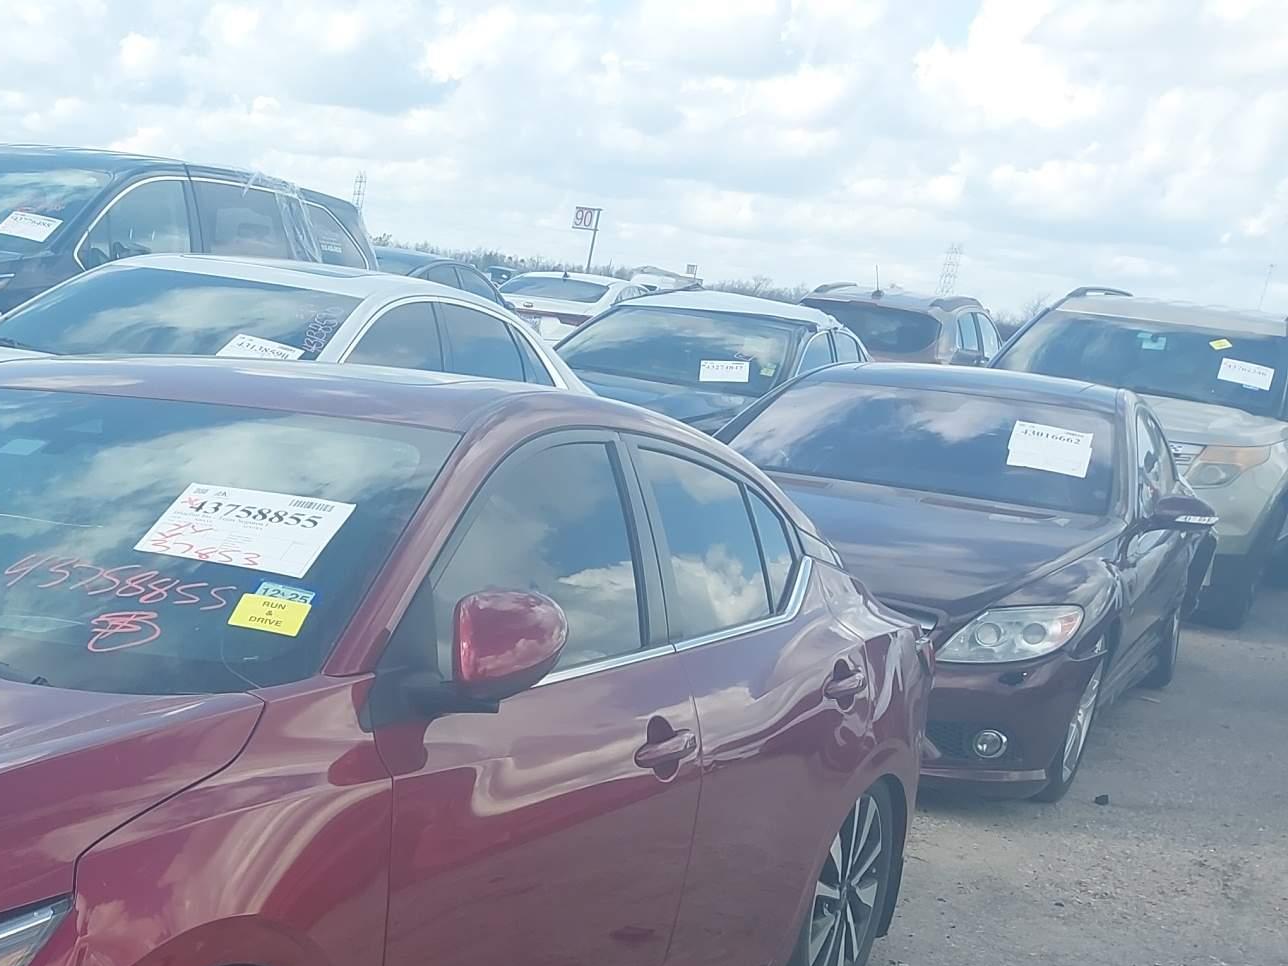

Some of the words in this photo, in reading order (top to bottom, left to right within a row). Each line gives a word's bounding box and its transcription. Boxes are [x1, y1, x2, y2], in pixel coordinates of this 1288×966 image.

[575, 208, 593, 228] 90
[190, 499, 324, 529] 43758855
[262, 601, 287, 610] RUN
[248, 615, 283, 627] DRIVE
